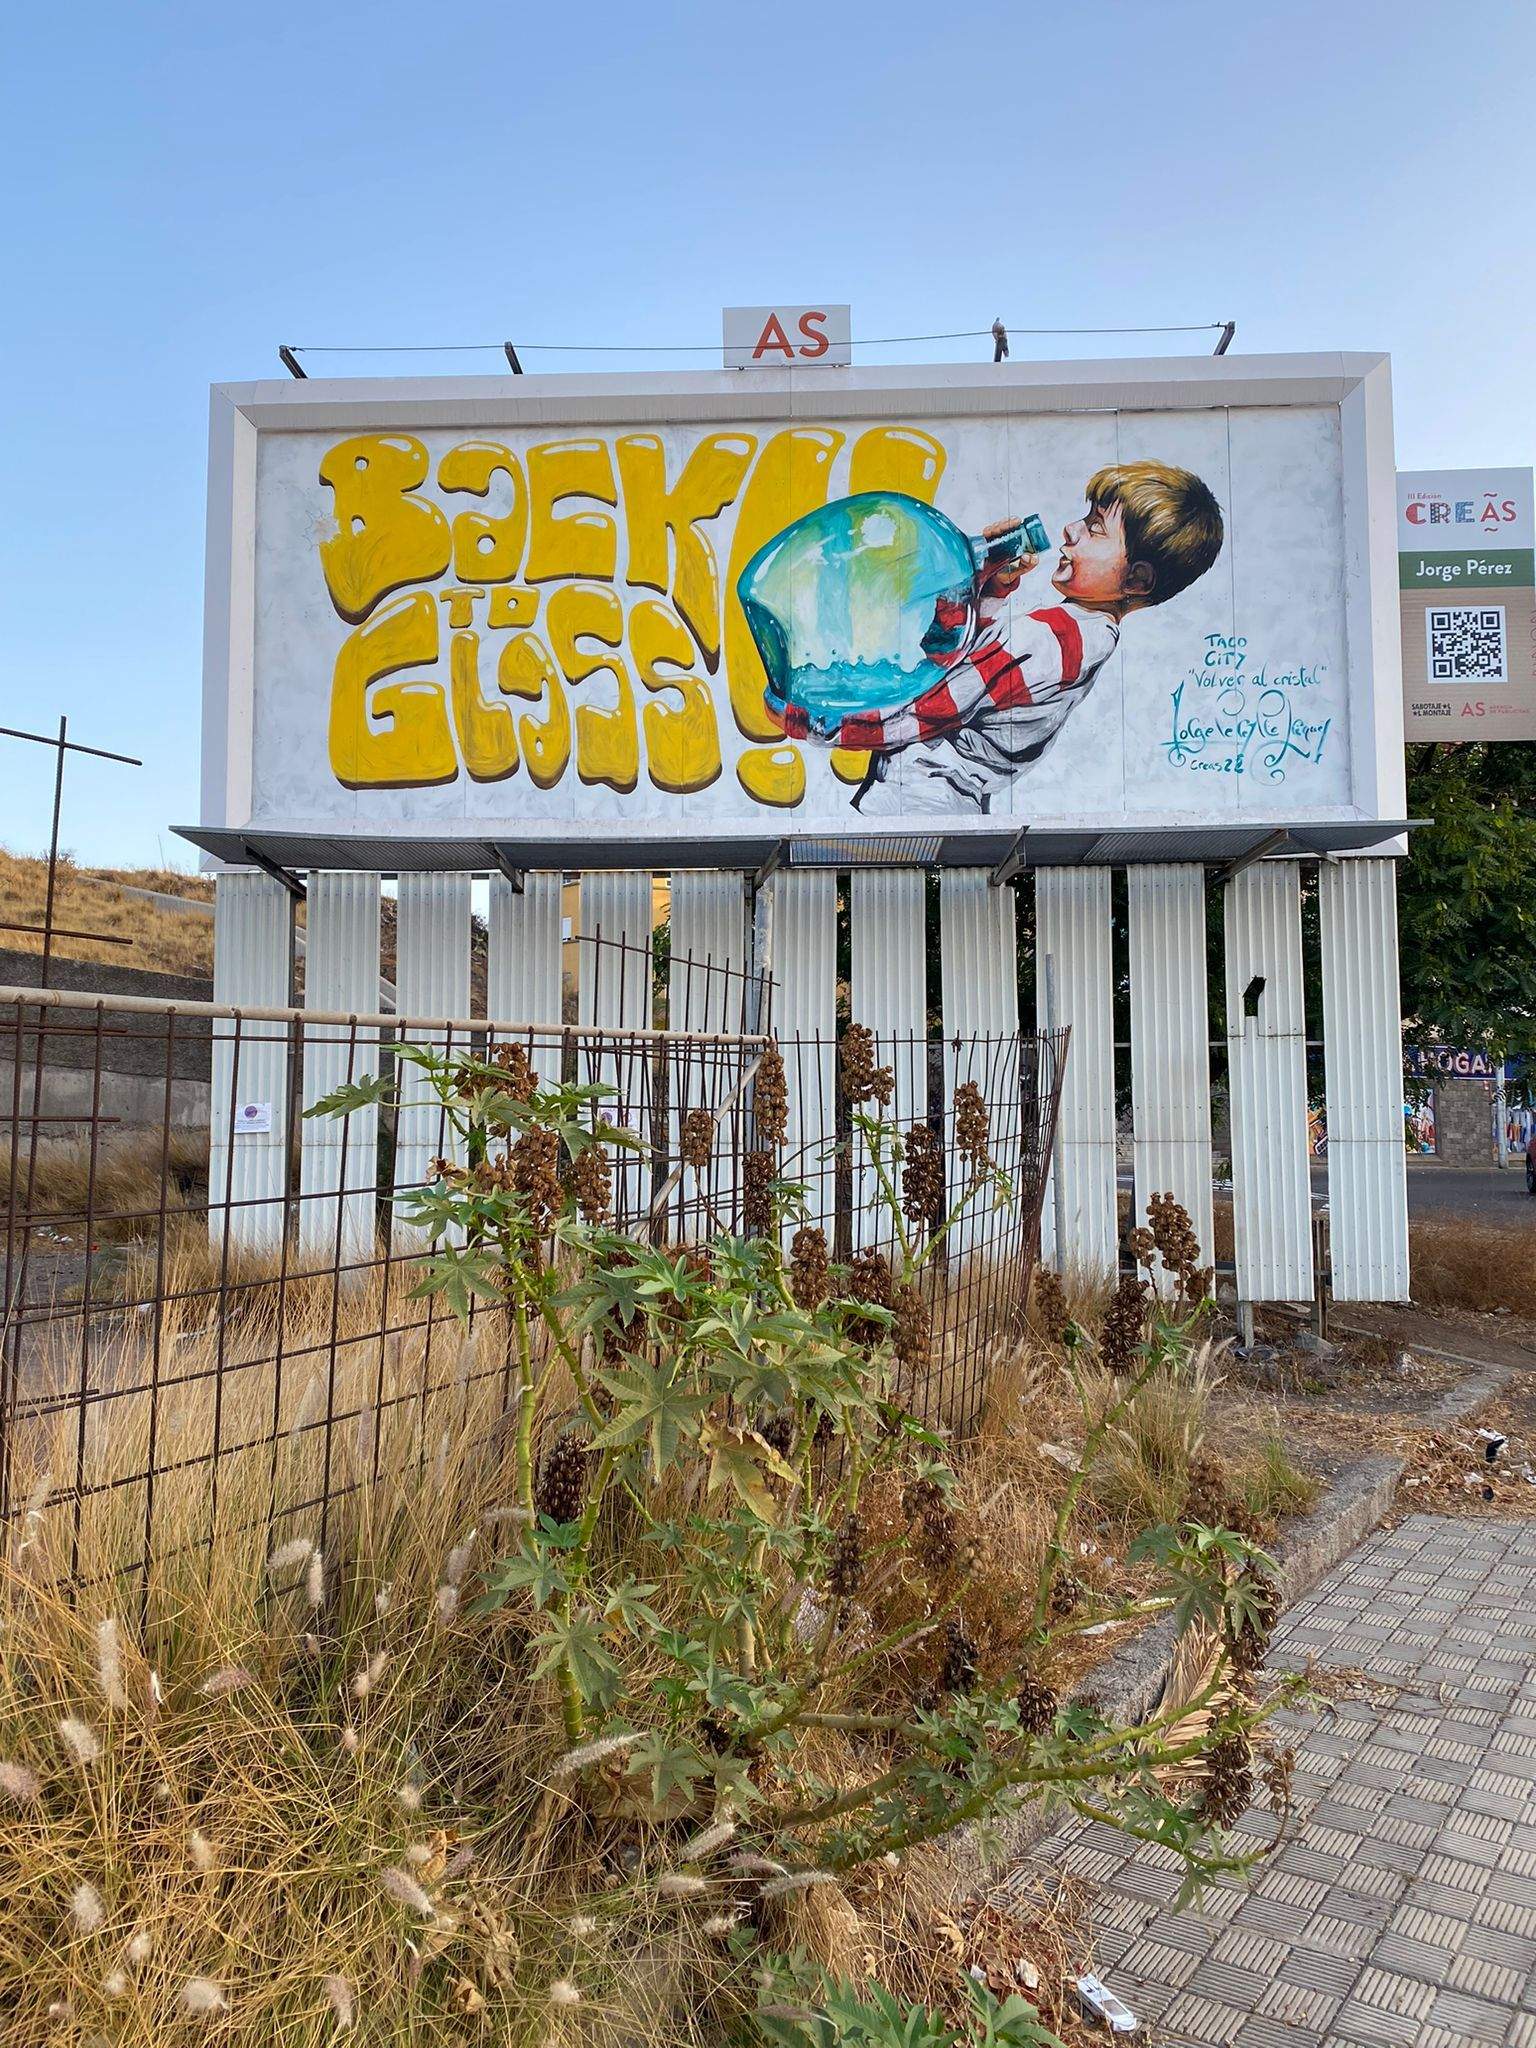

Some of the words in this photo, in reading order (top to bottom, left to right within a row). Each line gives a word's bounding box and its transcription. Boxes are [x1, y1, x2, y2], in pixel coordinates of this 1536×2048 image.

[752, 311, 830, 359] AS
[1416, 560, 1461, 582] Jorge
[1466, 559, 1512, 575] Pérez
[440, 586, 541, 629] TO
[1251, 662, 1268, 687] al
[1461, 702, 1485, 717] AS
